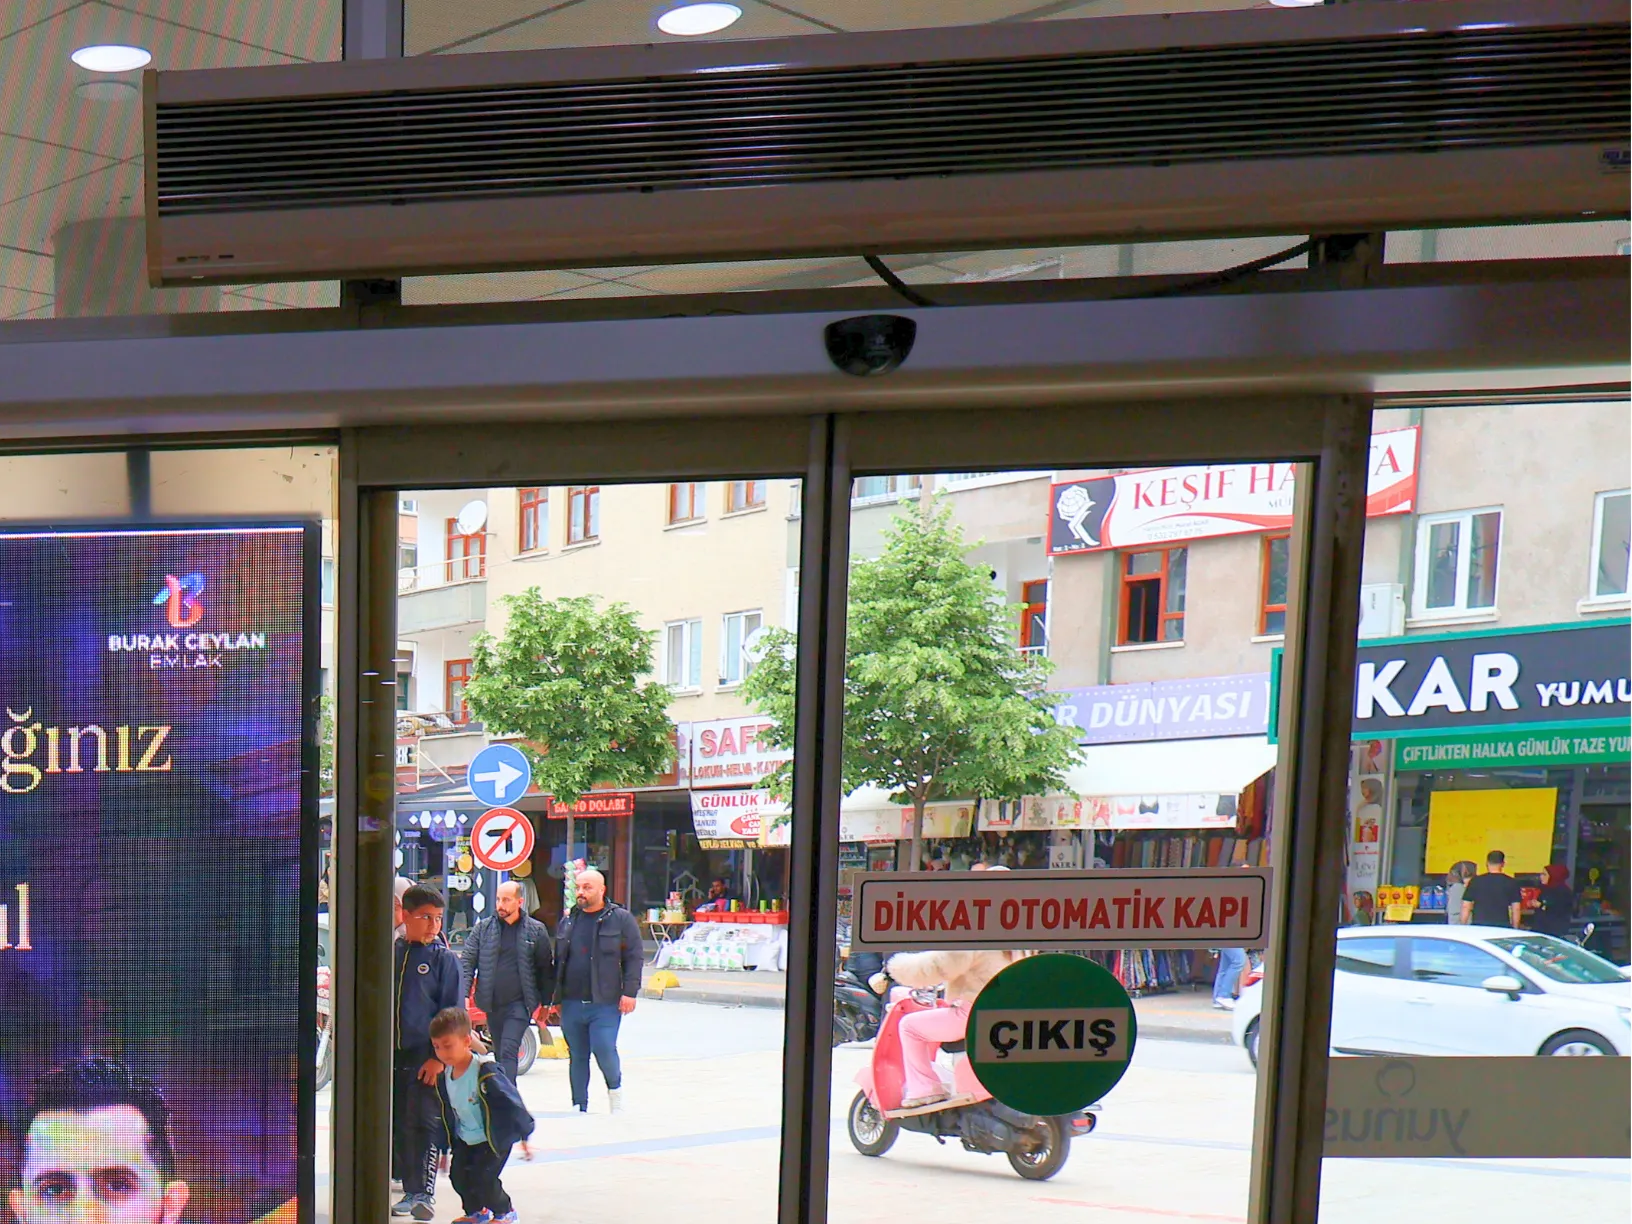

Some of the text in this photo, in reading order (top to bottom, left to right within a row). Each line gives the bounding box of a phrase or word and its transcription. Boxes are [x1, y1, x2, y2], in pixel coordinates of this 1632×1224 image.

[1134, 465, 1236, 511] KEŞİF
[108, 632, 267, 651] BURAK CEYLAN
[1089, 690, 1253, 729] DÜNYASI
[1472, 741, 1515, 759] HALKA
[1517, 737, 1570, 756] GÜNLÜK
[1572, 737, 1606, 755] TAZE
[1608, 736, 1630, 753] YU
[588, 798, 626, 812] DOLABI
[701, 792, 759, 808] GÜNLÜK
[874, 888, 1250, 932] DİKKAT OTOMATİK KAPI
[988, 1017, 1117, 1060] ÇIKIŞ
